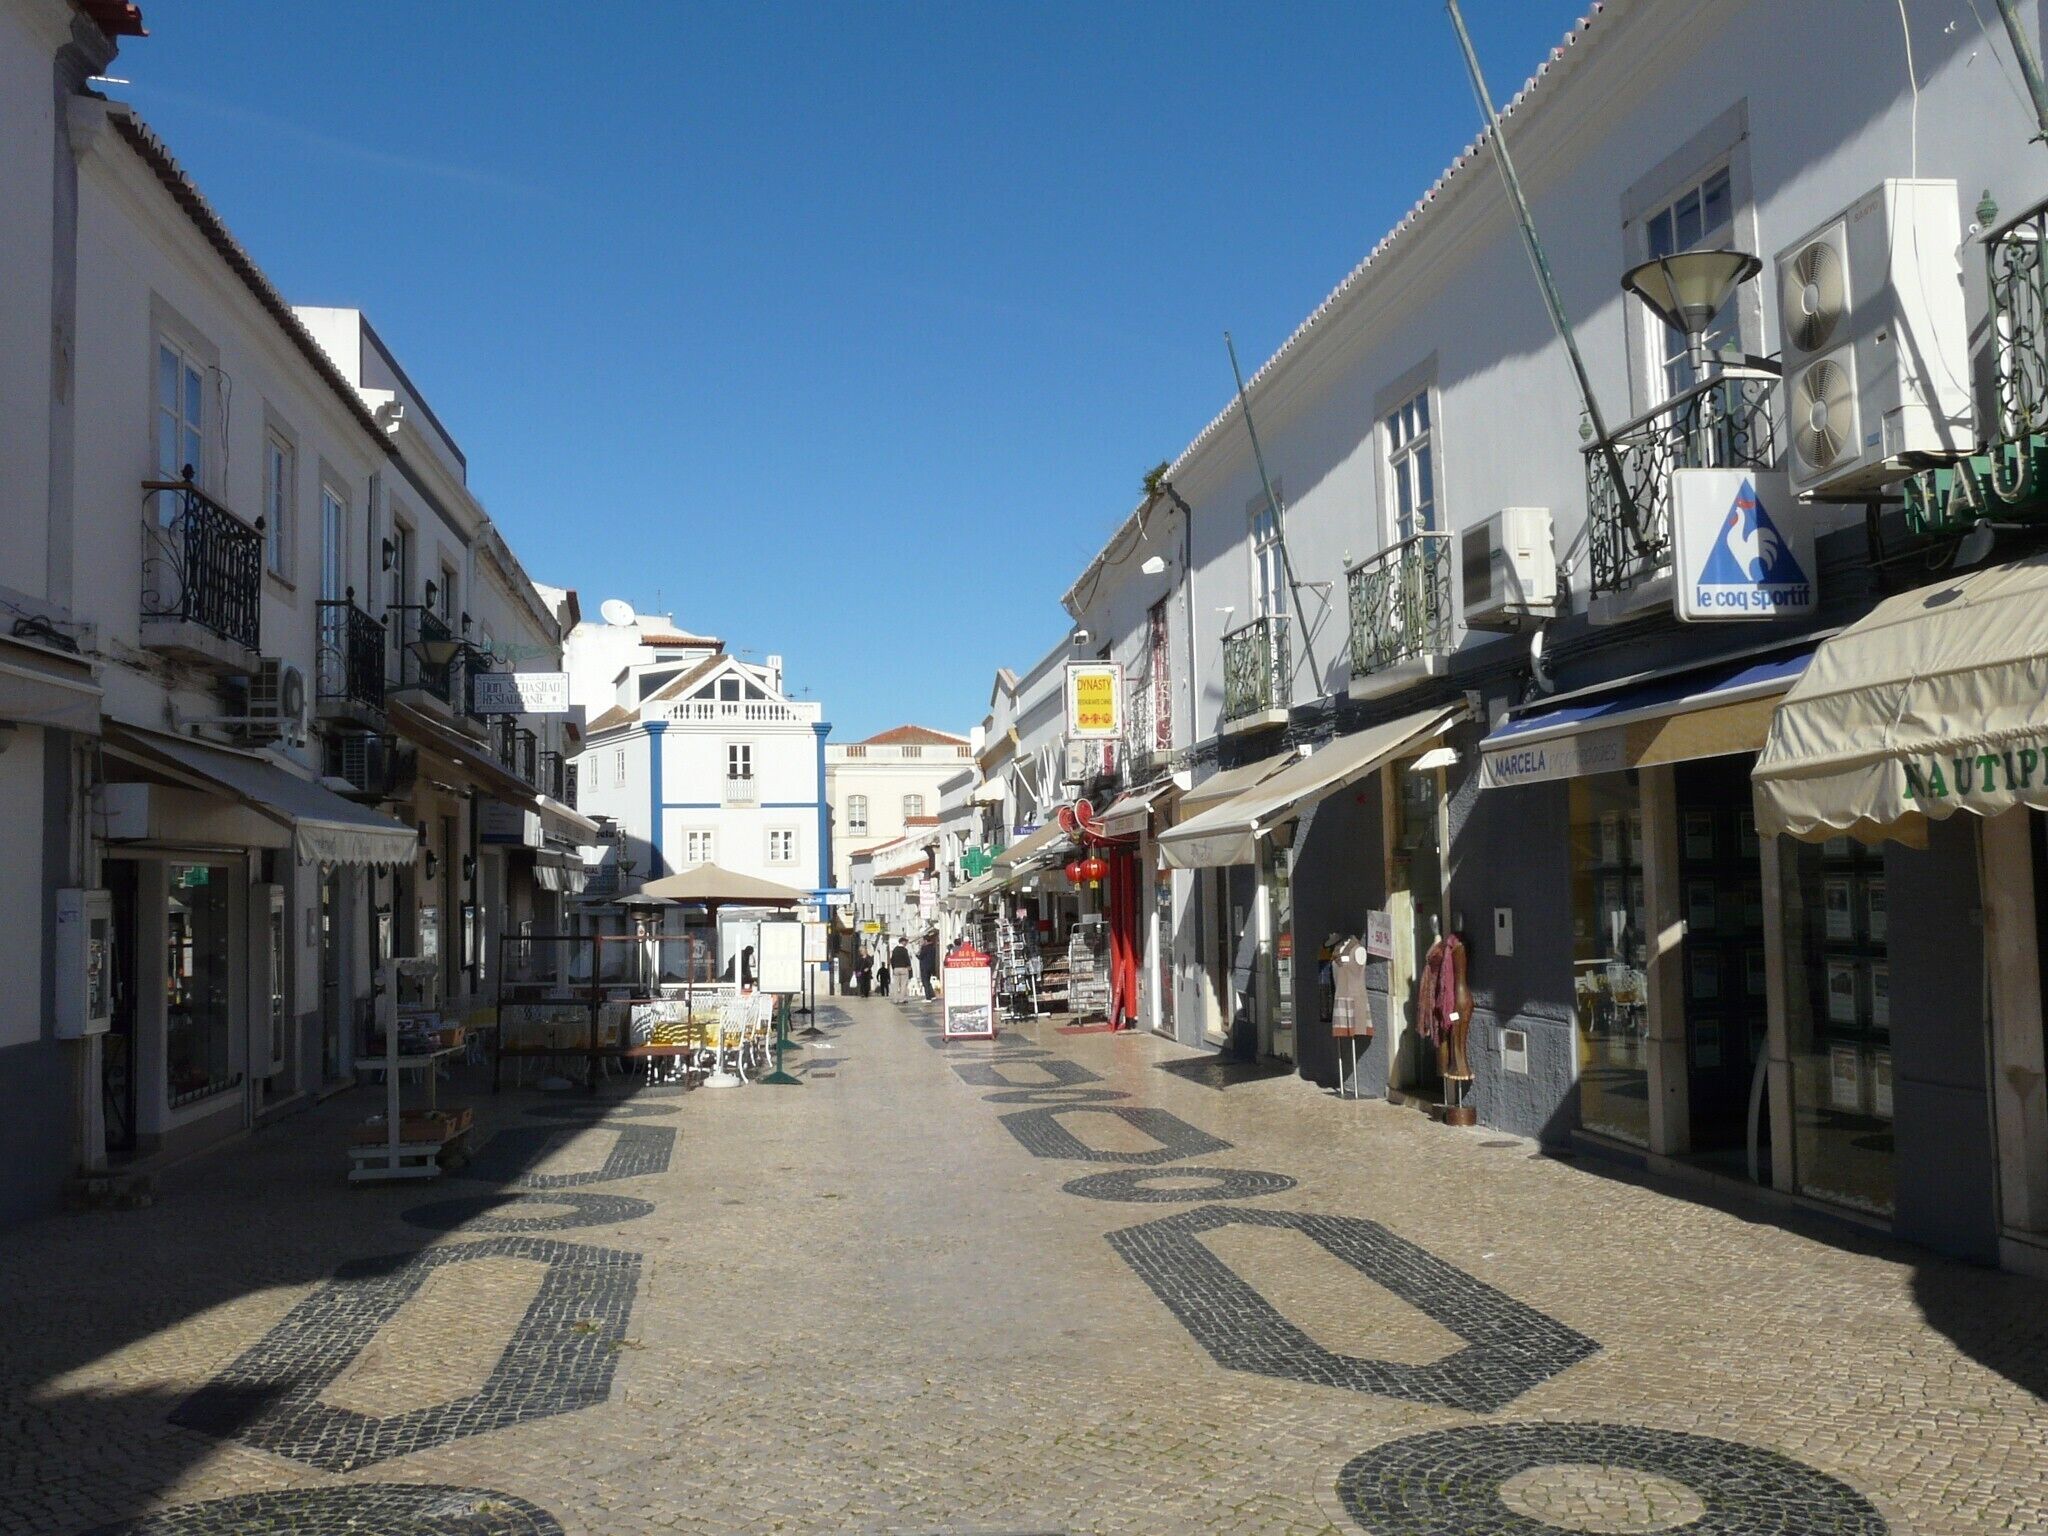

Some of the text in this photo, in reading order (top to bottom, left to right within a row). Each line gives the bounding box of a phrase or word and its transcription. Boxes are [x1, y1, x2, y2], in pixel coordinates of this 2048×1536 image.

[1696, 585, 1810, 610] le coq sportif
[1077, 679, 1112, 691] DYNASTY
[1495, 750, 1546, 777] MARCELA
[1903, 747, 2048, 799] NAUTIP
